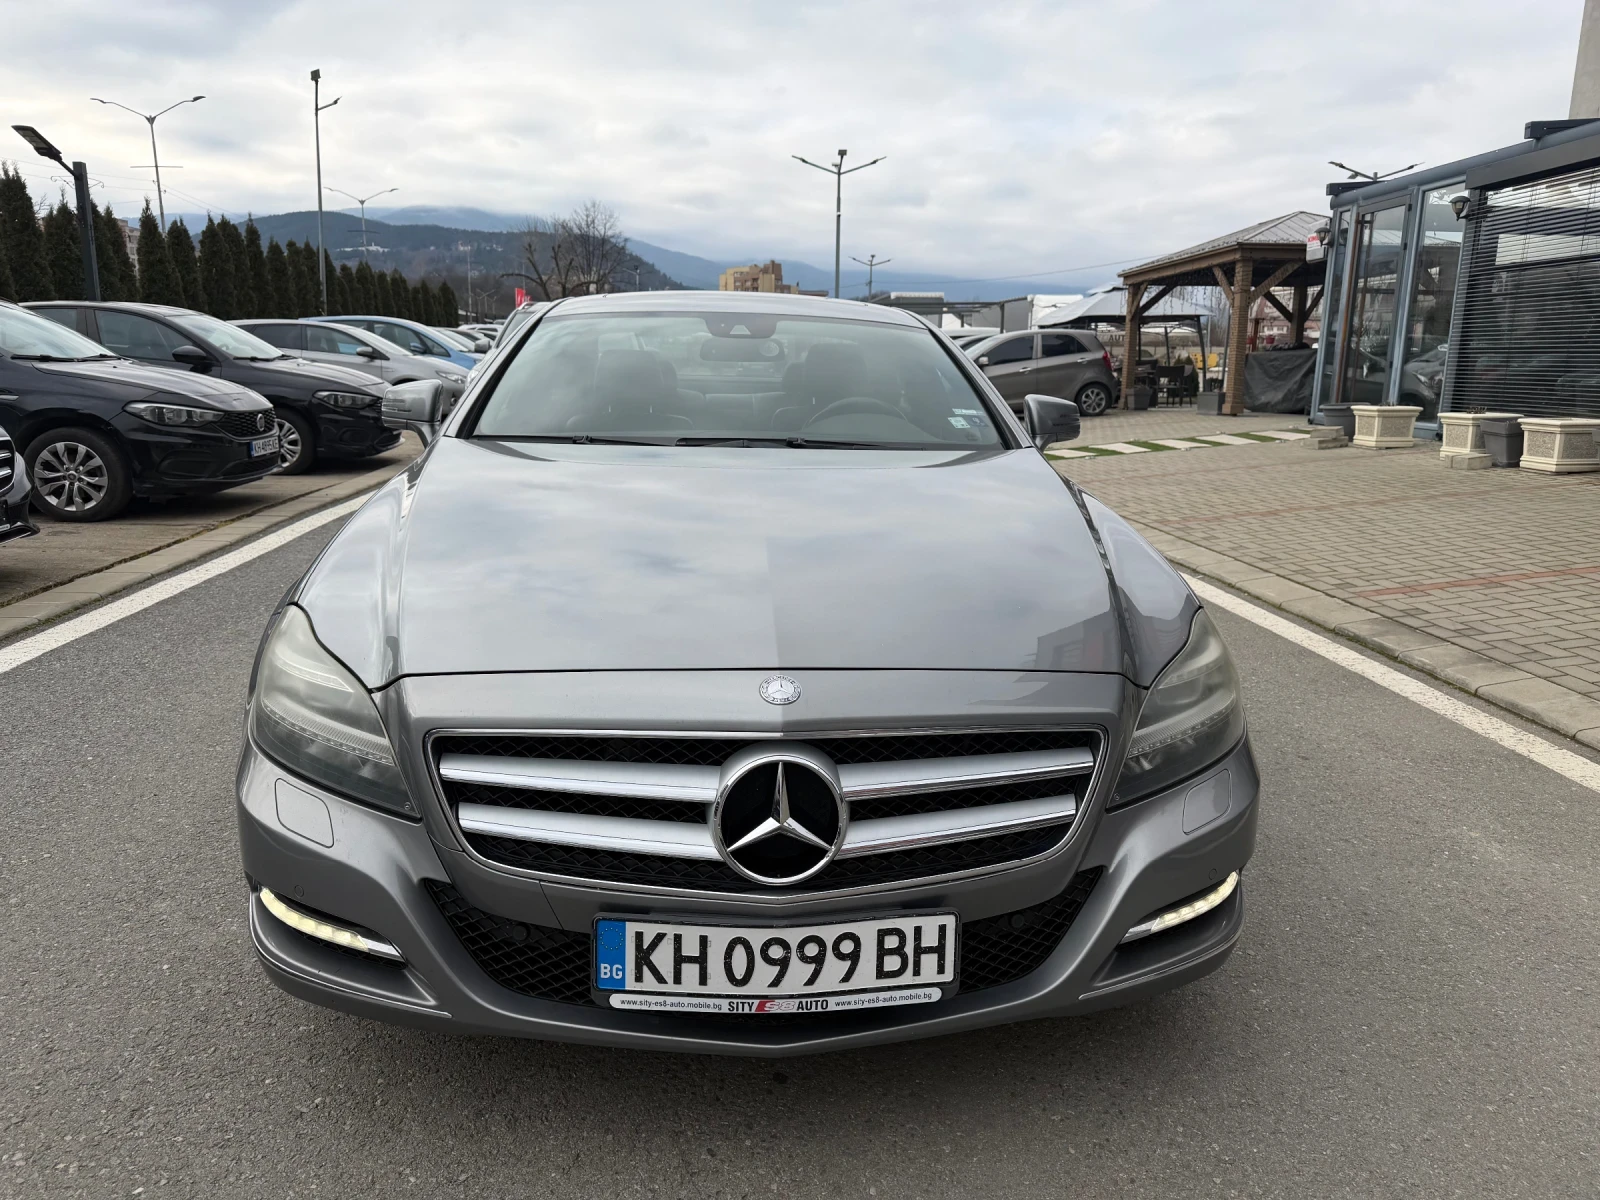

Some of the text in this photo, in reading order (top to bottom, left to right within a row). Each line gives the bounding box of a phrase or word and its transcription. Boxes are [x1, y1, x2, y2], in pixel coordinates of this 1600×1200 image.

[635, 924, 947, 988] KH 0999 BH
[600, 963, 623, 979] BG
[620, 999, 722, 1011] www.sity-es8-auto.mobile.bg
[728, 1001, 754, 1012] SITY
[796, 999, 829, 1011] AUTO
[835, 992, 932, 1007] www.sity-es8-auto.mobile.bg
